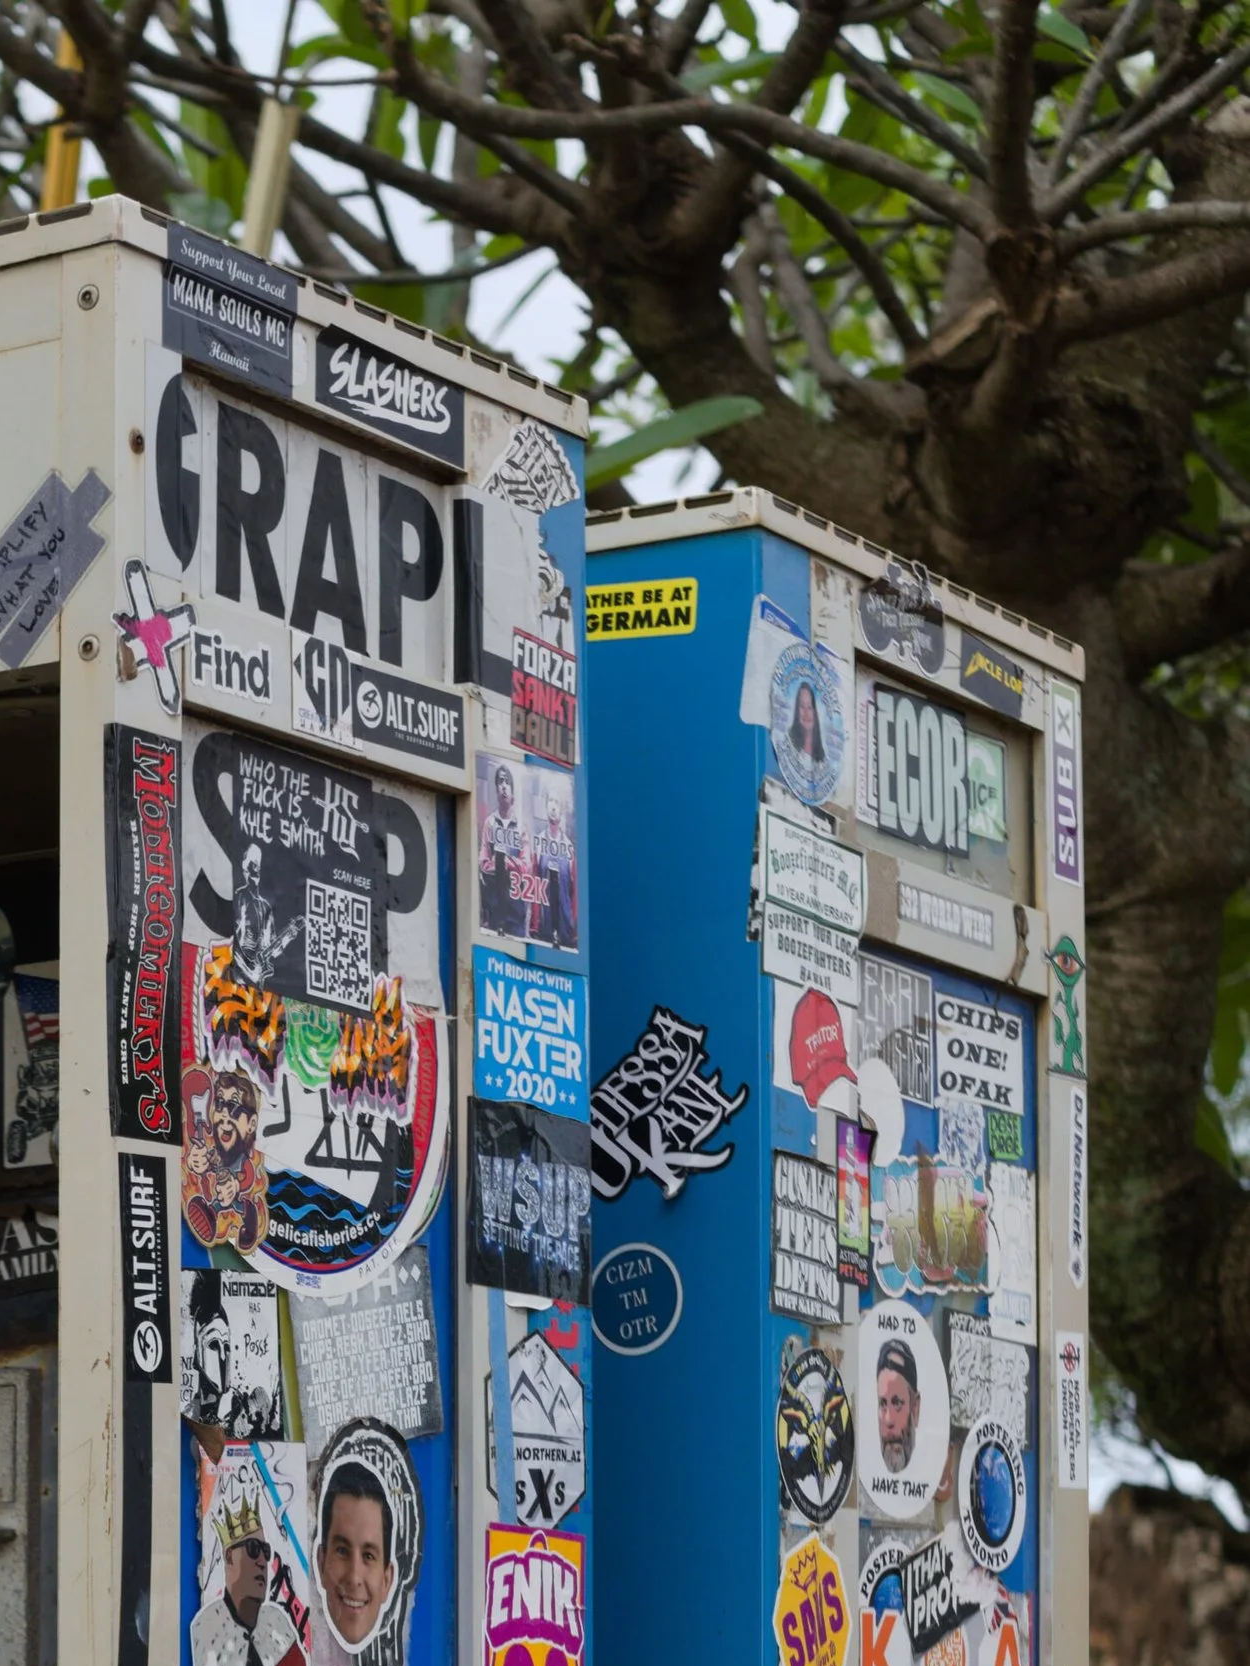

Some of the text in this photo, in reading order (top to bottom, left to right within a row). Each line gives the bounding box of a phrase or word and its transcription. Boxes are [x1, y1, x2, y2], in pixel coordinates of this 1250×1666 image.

[180, 239, 287, 301] Support Your Local
[173, 274, 285, 347] MANA SOULS MC
[208, 341, 250, 373] Hawaii
[329, 343, 451, 432] SLASHERS
[38, 528, 66, 562] YOU
[19, 576, 59, 633] LOVE
[642, 586, 692, 604] BE AT
[586, 606, 691, 634] GERMAN
[194, 636, 271, 698] Find
[512, 636, 576, 695] FORZA
[386, 691, 458, 746] ALT.SURF
[511, 670, 577, 729] SANKT
[240, 751, 310, 796] WHO THE
[243, 778, 302, 818] FUCK IS
[239, 805, 326, 859] KYLE SMITH
[333, 868, 372, 890] SCAN HERE
[509, 871, 550, 906] 32K
[119, 819, 141, 1084] BARBER SHOP SANTA CRUZ
[133, 737, 177, 1136] MONTGOMERY'S
[488, 956, 573, 993] I'M RIDING WITH
[485, 979, 575, 1037] NASEN
[937, 1000, 1020, 1041] CHIPS
[478, 1025, 583, 1082] FUXTER
[947, 1038, 1009, 1072] ONE!
[506, 1068, 557, 1106] 2020
[939, 1071, 1012, 1107] OFAK
[130, 1166, 157, 1316] ALT.SURF
[482, 1222, 580, 1271] SETTING THE PACE
[605, 1256, 653, 1286] CIZM
[248, 1302, 261, 1314] HAS
[619, 1289, 648, 1310] TM
[618, 1313, 659, 1341] OTR
[878, 1313, 917, 1335] HAD TO
[976, 1421, 1025, 1497] POSTERING
[872, 1478, 929, 1500] HAVE THAT
[963, 1511, 1009, 1565] TORONTO
